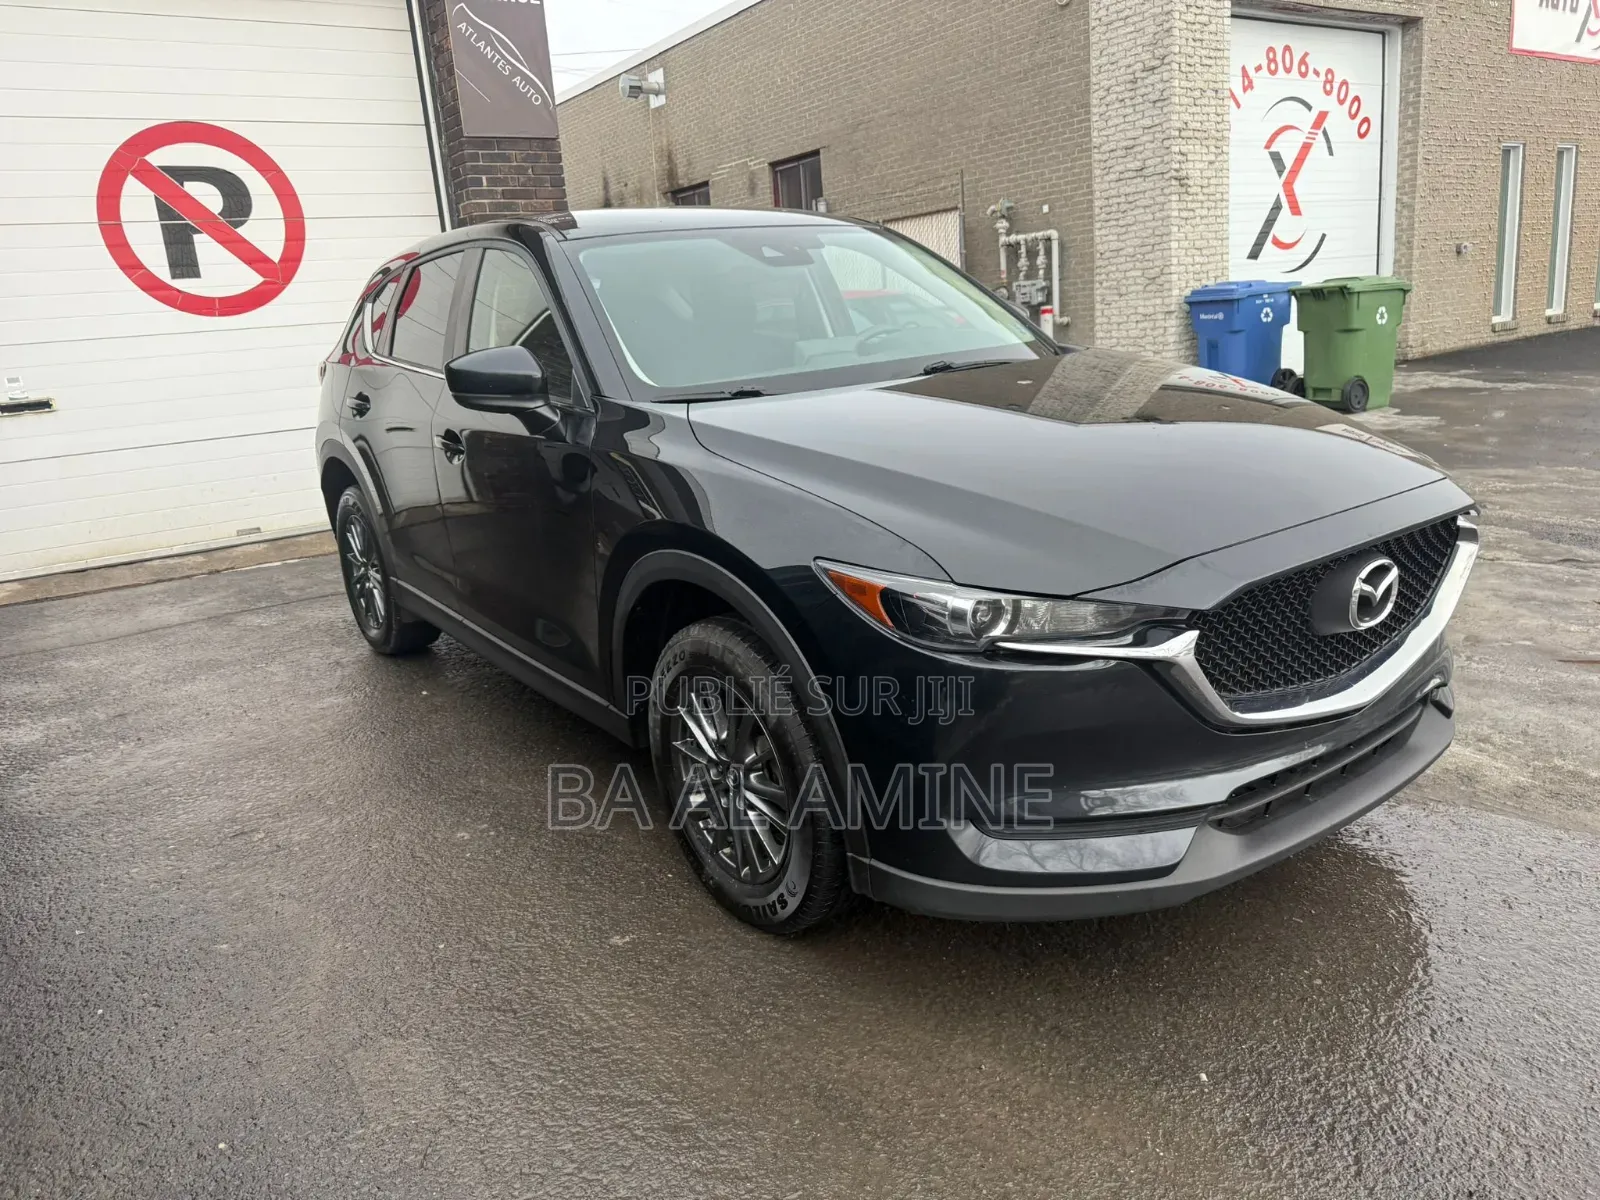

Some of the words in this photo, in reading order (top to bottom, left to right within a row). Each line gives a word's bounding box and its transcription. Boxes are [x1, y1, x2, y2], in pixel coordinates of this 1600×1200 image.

[457, 22, 512, 76] ATLANTES
[512, 75, 542, 106] AUTO
[1229, 44, 1371, 140] 14-806-8000
